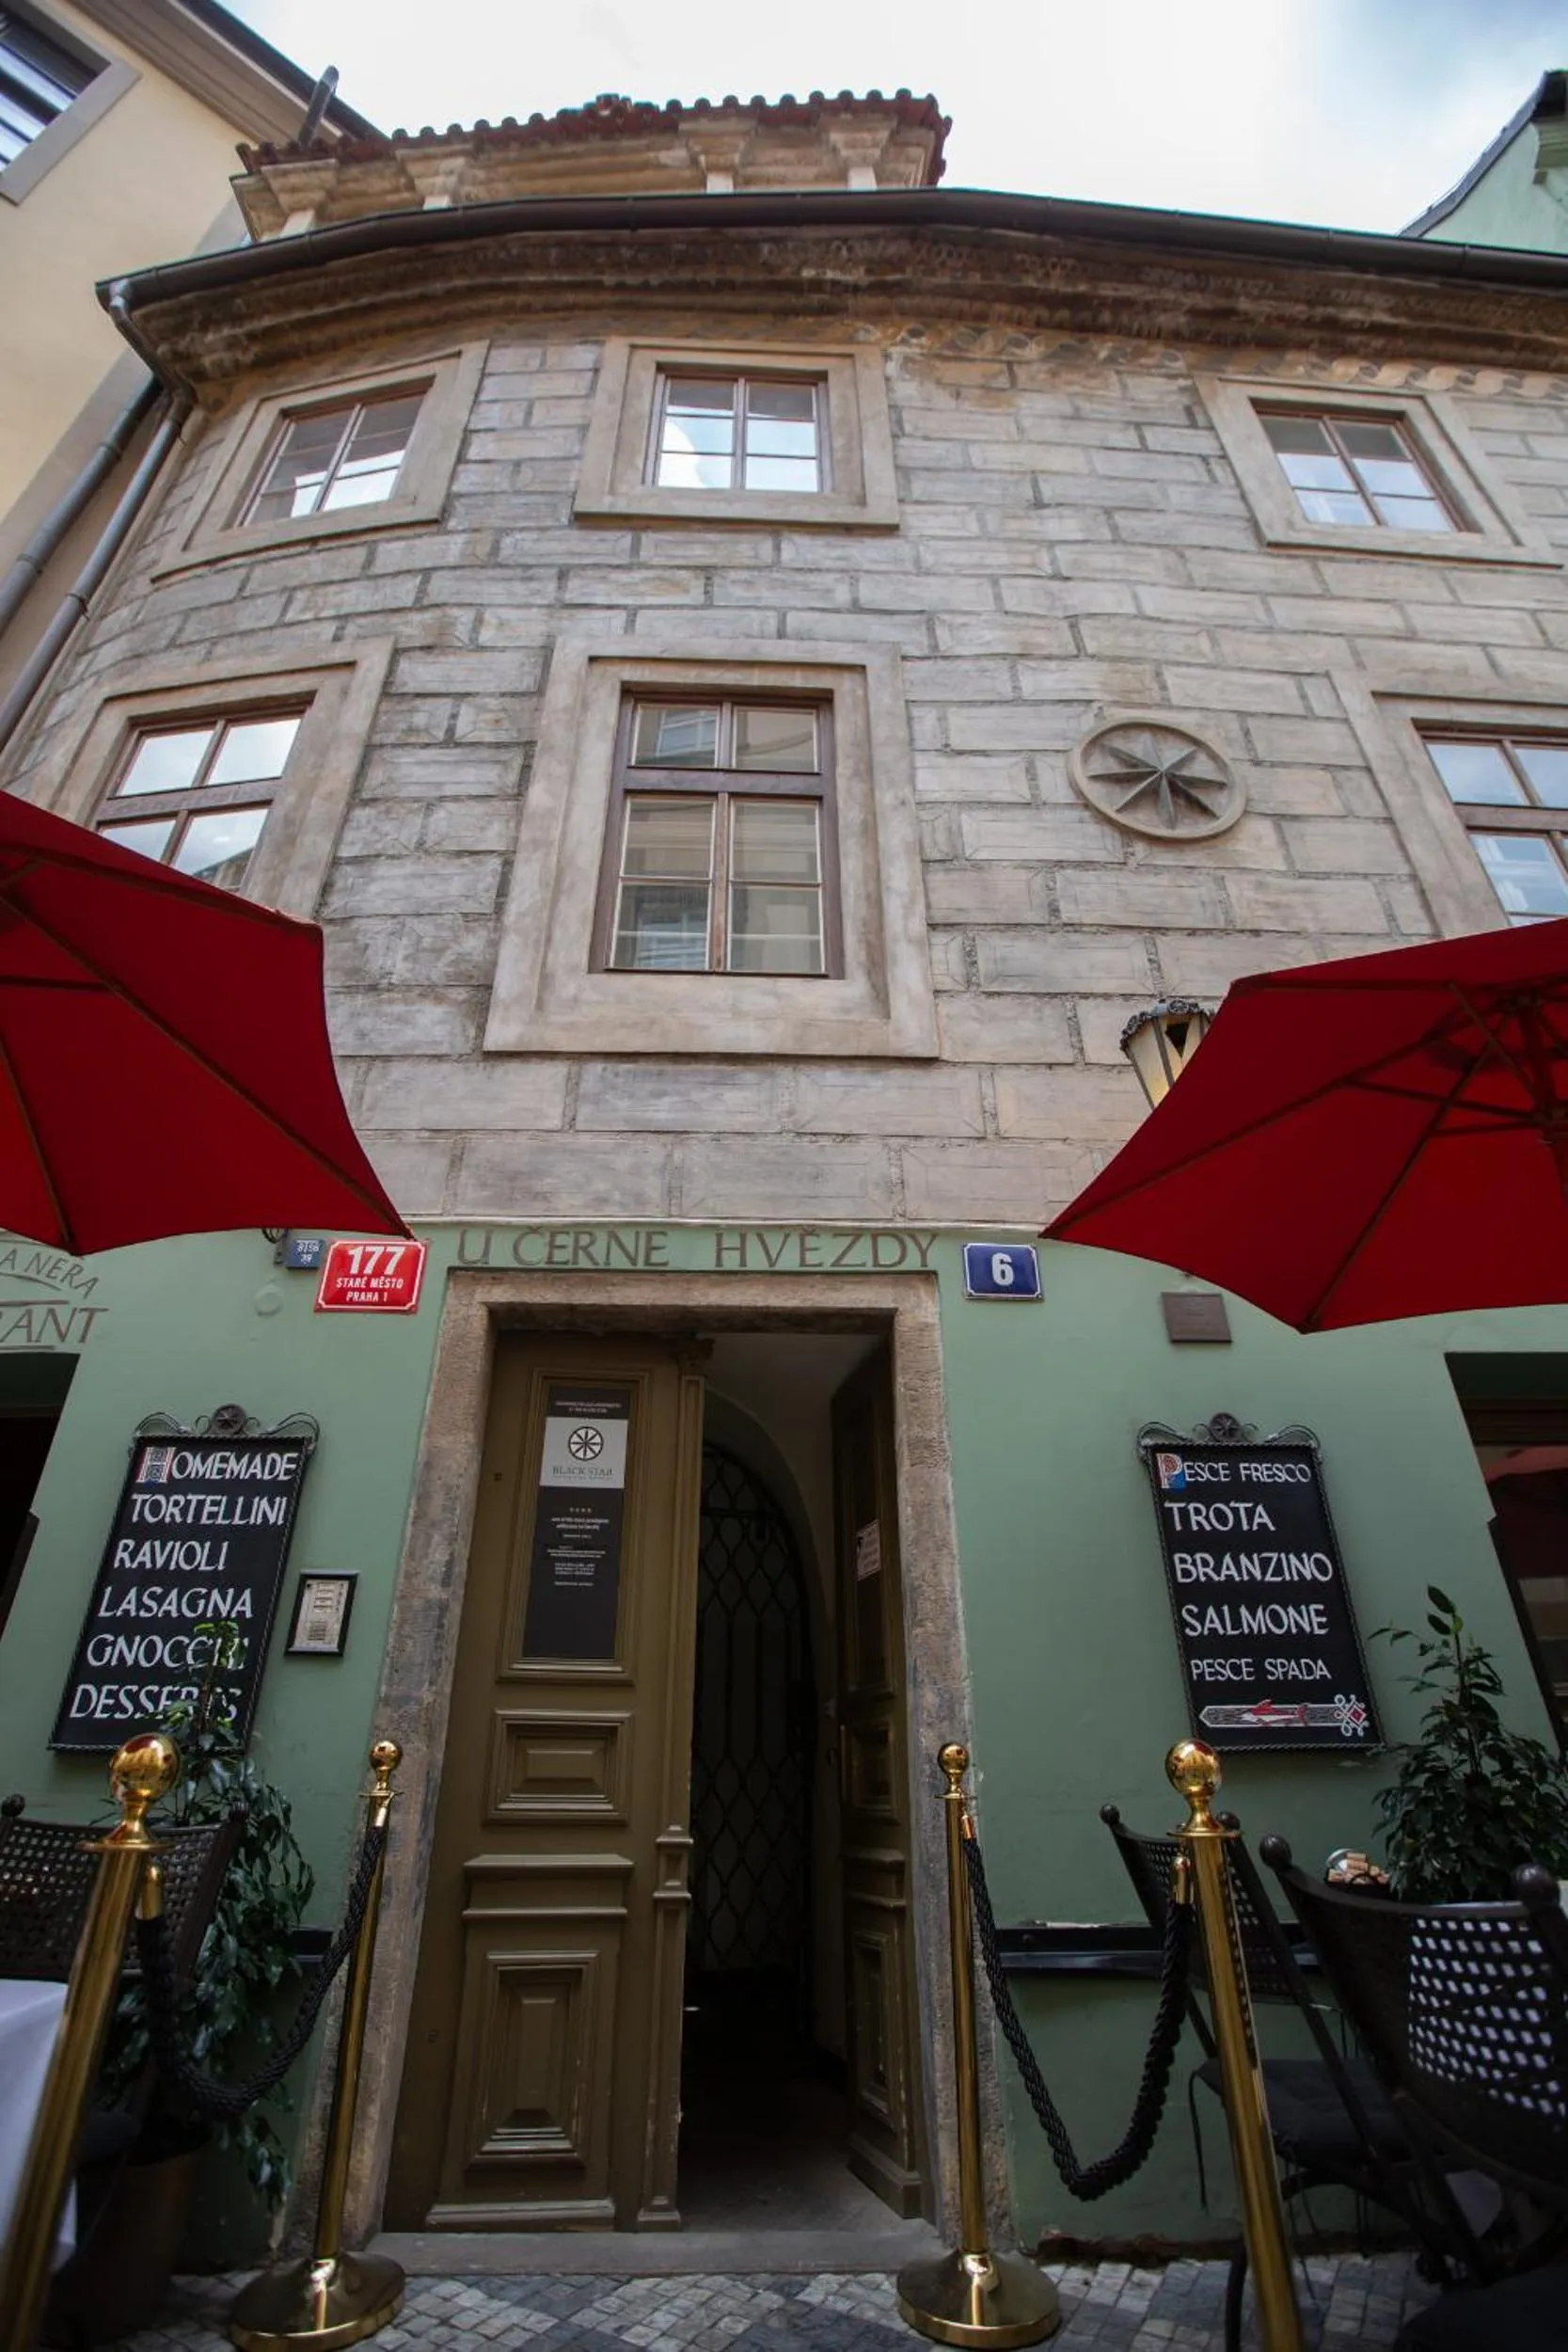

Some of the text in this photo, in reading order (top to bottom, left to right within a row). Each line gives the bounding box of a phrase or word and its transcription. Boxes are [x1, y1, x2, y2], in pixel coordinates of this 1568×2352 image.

[347, 1245, 406, 1275] 177
[457, 1228, 494, 1265] U
[713, 1226, 939, 1268] HVĚZDY
[24, 1251, 100, 1299] NERA
[336, 1276, 404, 1289] STARÉ MĚSTO
[990, 1252, 1014, 1287] 6
[345, 1291, 388, 1303] PRAHA 1
[0, 1307, 109, 1343] ANT
[135, 1446, 299, 1484] HOMEMADE
[1155, 1453, 1311, 1489] PESCE FRESCO
[130, 1492, 289, 1526] TORTELLINI
[1164, 1501, 1275, 1532] TROTA
[113, 1538, 230, 1572] RAVIOLI
[1173, 1551, 1334, 1583] BRANZINO
[97, 1585, 254, 1619] LASAGNA
[1180, 1603, 1331, 1638] SALMONE
[1190, 1658, 1332, 1681] PESCE SPADA
